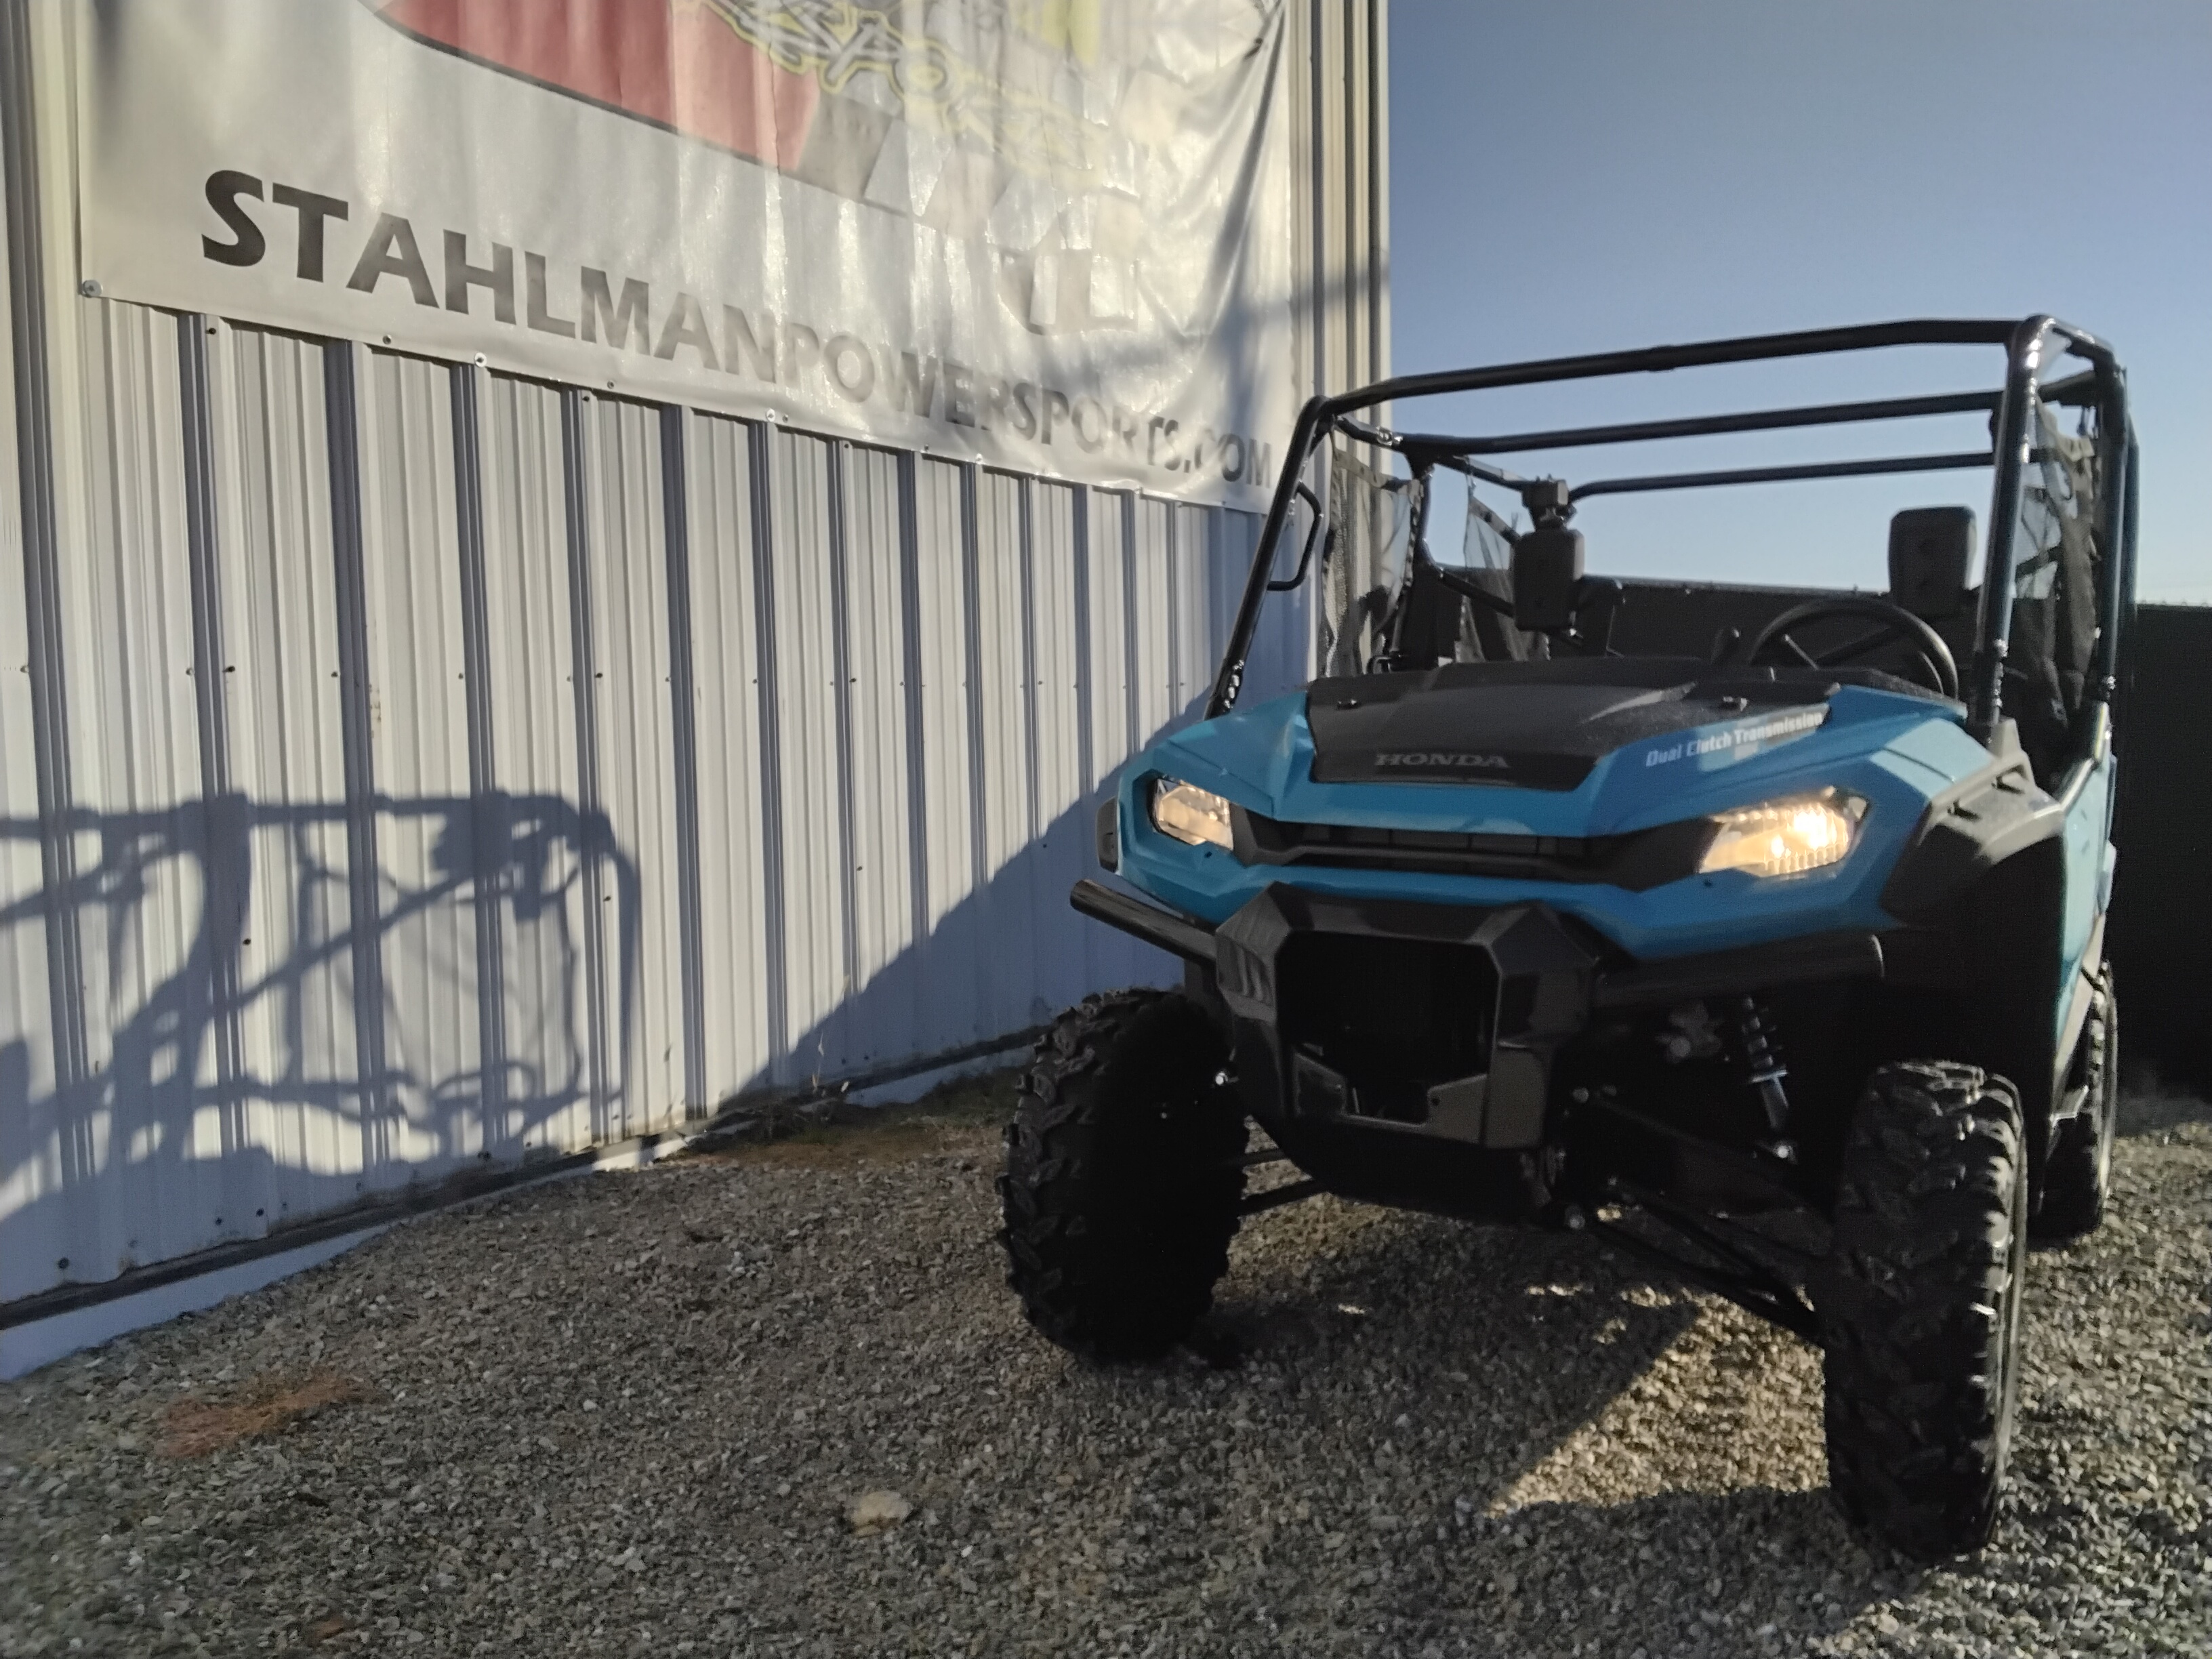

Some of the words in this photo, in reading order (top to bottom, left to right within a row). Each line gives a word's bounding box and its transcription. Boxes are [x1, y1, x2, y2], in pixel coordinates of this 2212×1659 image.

[1645, 745, 1683, 766] Dual
[1686, 731, 1732, 757] Clutch
[1734, 712, 1824, 745] Transmission
[1374, 753, 1511, 769] HONDA
